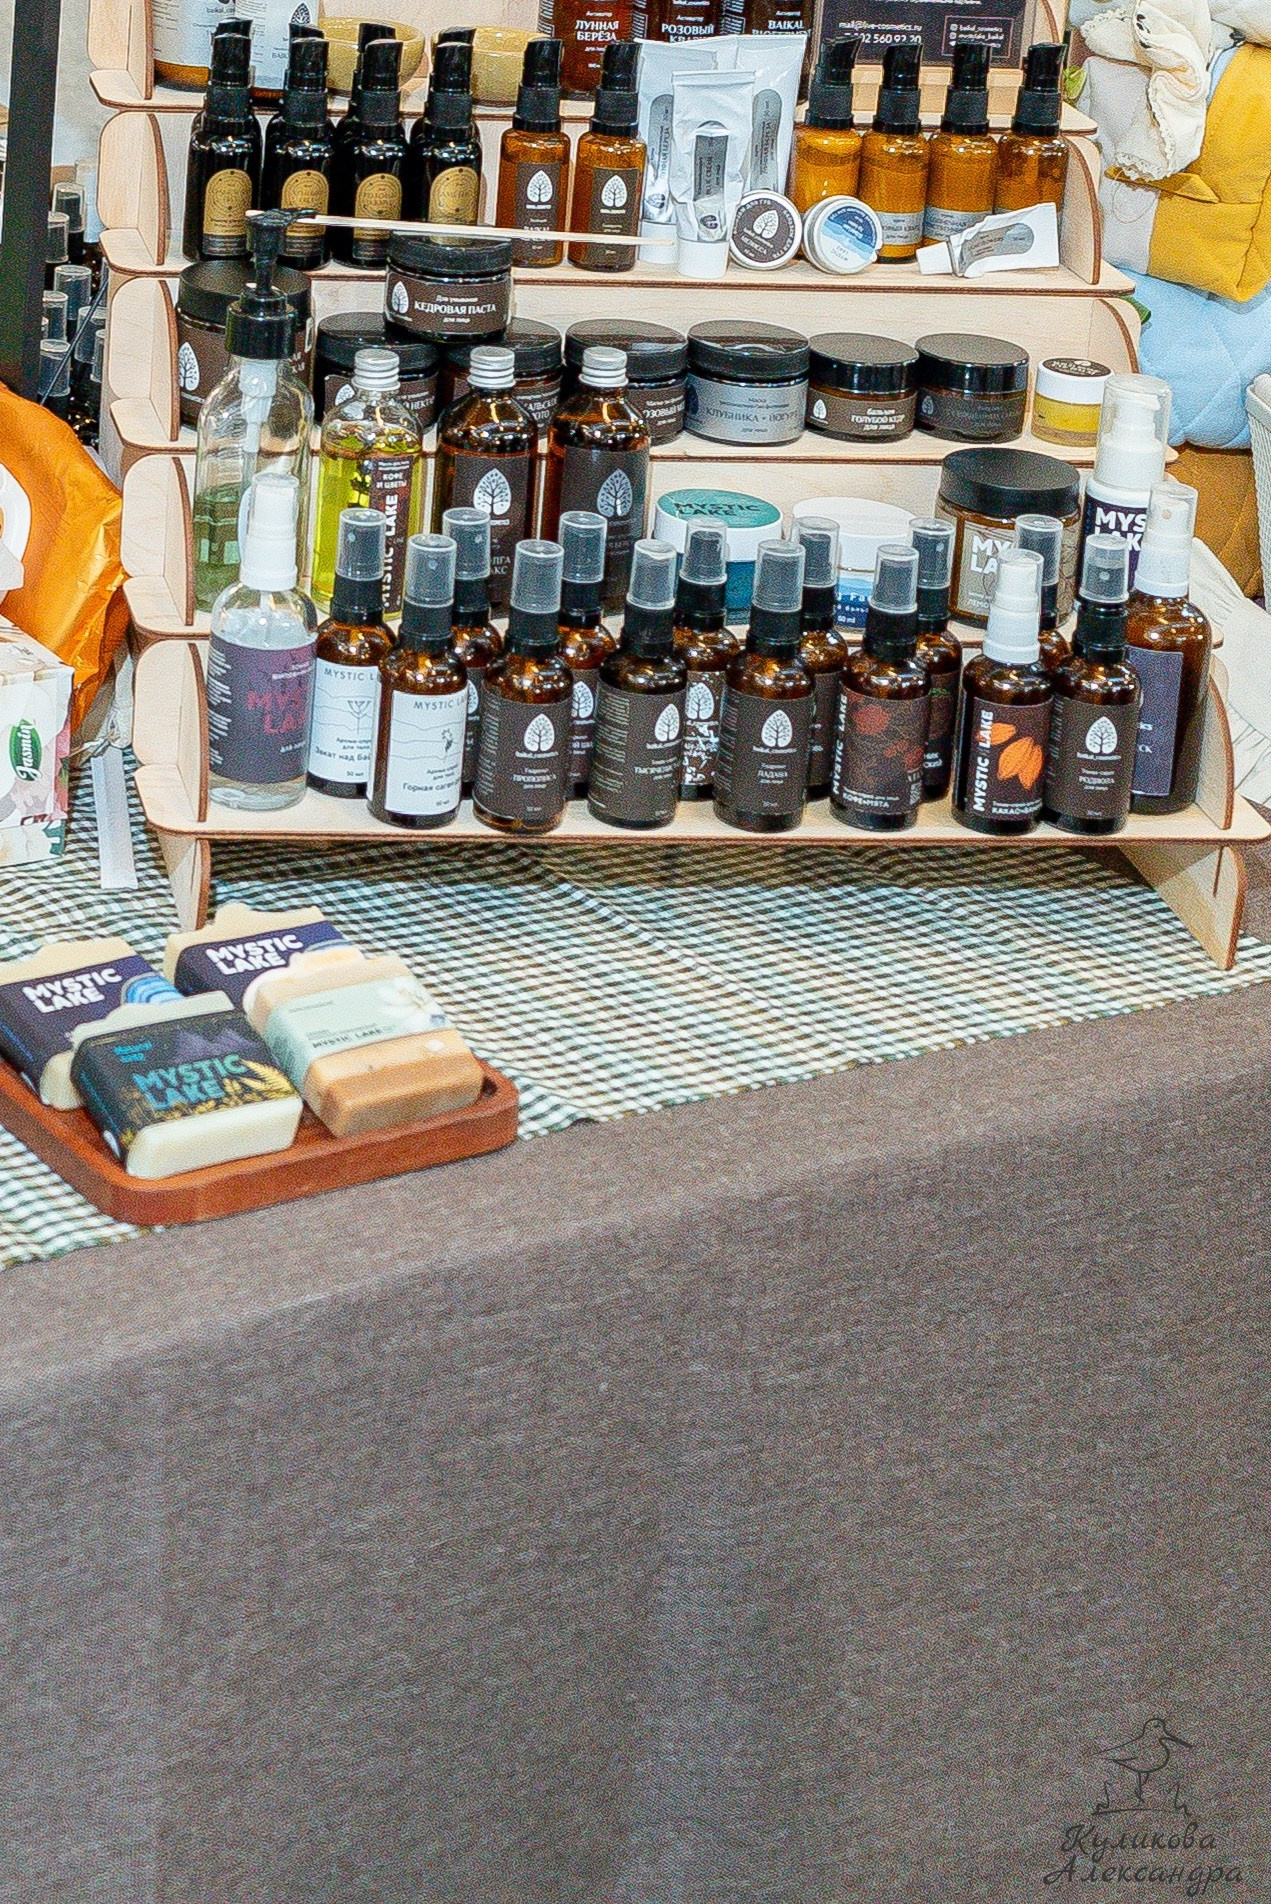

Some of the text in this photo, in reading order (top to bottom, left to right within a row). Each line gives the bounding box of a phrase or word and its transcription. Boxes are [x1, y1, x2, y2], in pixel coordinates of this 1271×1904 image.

[575, 19, 619, 31] ЛУННАЯ
[661, 22, 715, 36] РОЗОВЫЙ
[768, 20, 804, 31] BAIKAL
[576, 29, 618, 42] БЕРЁЗА
[873, 33, 892, 44] 560
[414, 300, 496, 314] КЕДРОВАЯ ПАСТА
[383, 473, 403, 481] КОФЕ
[384, 494, 398, 537] LAKE
[674, 501, 761, 512] MYSTIC
[678, 508, 738, 517] LAKE
[1094, 506, 1147, 532] MYS
[971, 555, 998, 574] LA
[324, 667, 365, 681] MYSTIC
[413, 699, 454, 711] MYSTIC
[838, 694, 848, 732] LAKE
[15, 724, 43, 781] Jasmin
[973, 710, 994, 812] MYSTIC LAKE
[402, 782, 434, 792] Горная
[206, 934, 303, 963] MYSTIC
[216, 951, 286, 975] LAKE
[22, 968, 122, 1001] MYSTIC
[34, 986, 105, 1013] LAKE
[313, 1027, 384, 1049] MYSTIC LAKE
[132, 1053, 249, 1091] MYSTIC
[144, 1079, 227, 1111] LAKE
